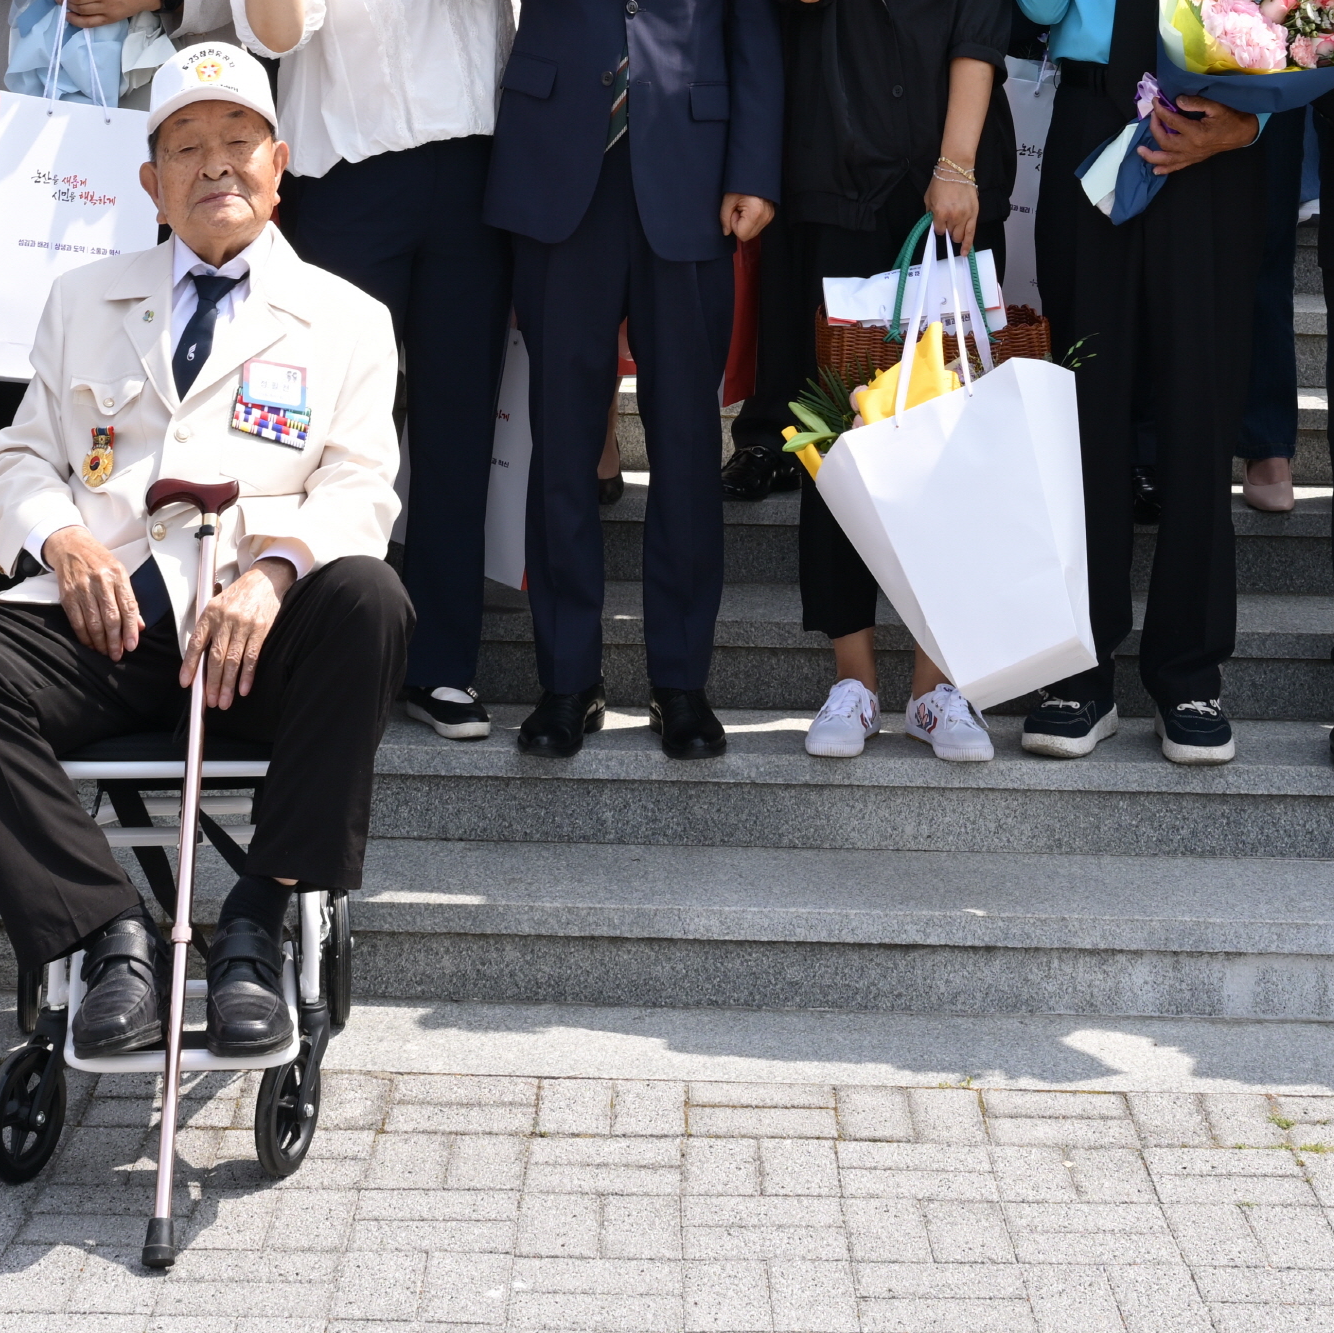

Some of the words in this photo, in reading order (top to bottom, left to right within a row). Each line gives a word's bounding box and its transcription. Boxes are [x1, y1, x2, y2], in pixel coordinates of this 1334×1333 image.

[30, 169, 60, 186] 논산을
[61, 174, 88, 189] 새롭게
[51, 188, 77, 203] 시민을
[78, 190, 117, 206] 행복하게
